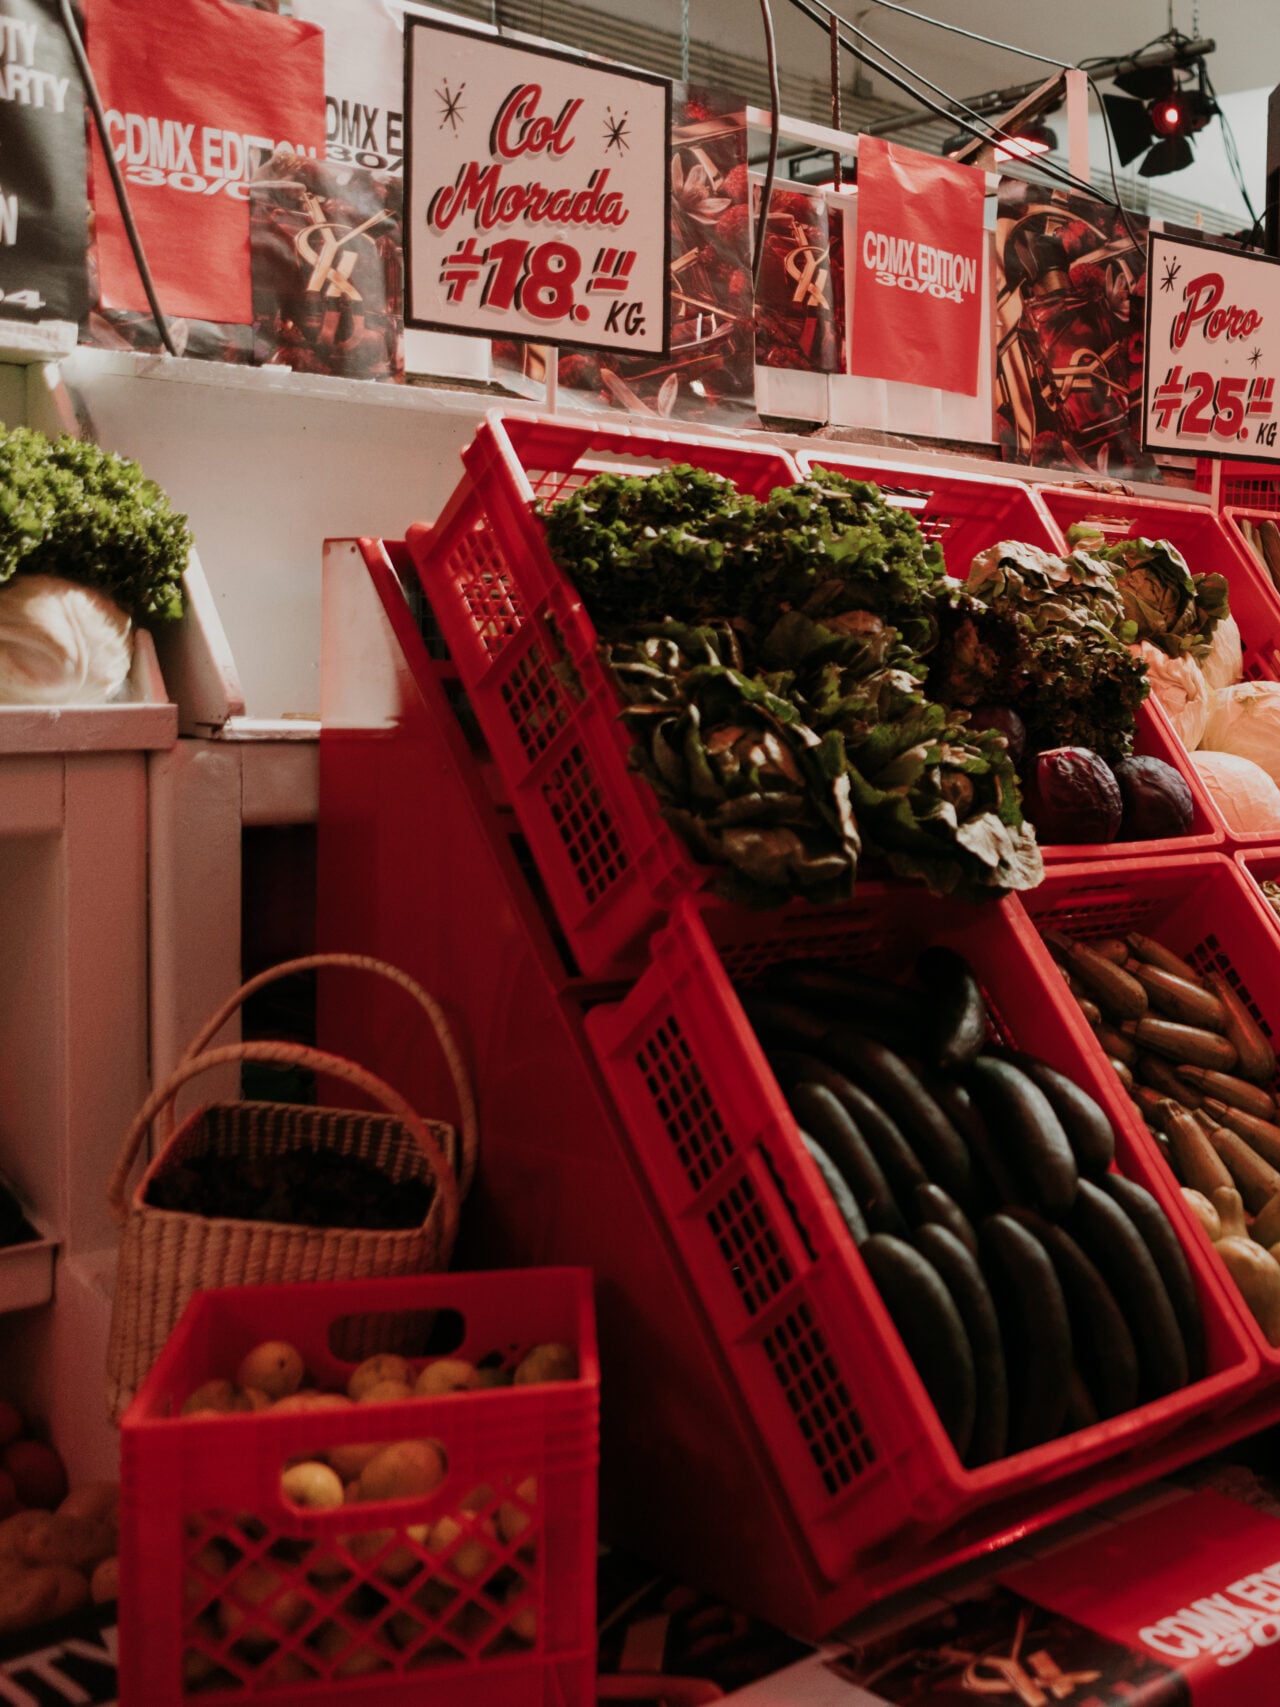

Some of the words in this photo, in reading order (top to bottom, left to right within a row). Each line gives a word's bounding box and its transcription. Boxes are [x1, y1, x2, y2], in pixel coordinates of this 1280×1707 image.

[104, 109, 198, 174] CDMX
[326, 97, 380, 153] DMX
[490, 83, 584, 158] Col
[427, 161, 629, 231] Morada
[862, 231, 915, 280] CDMX
[918, 244, 977, 294] EDITION
[875, 270, 964, 304] 30/04
[1171, 272, 1264, 350] Poro
[1255, 421, 1278, 447] KG
[1138, 1592, 1250, 1660] CDMX
